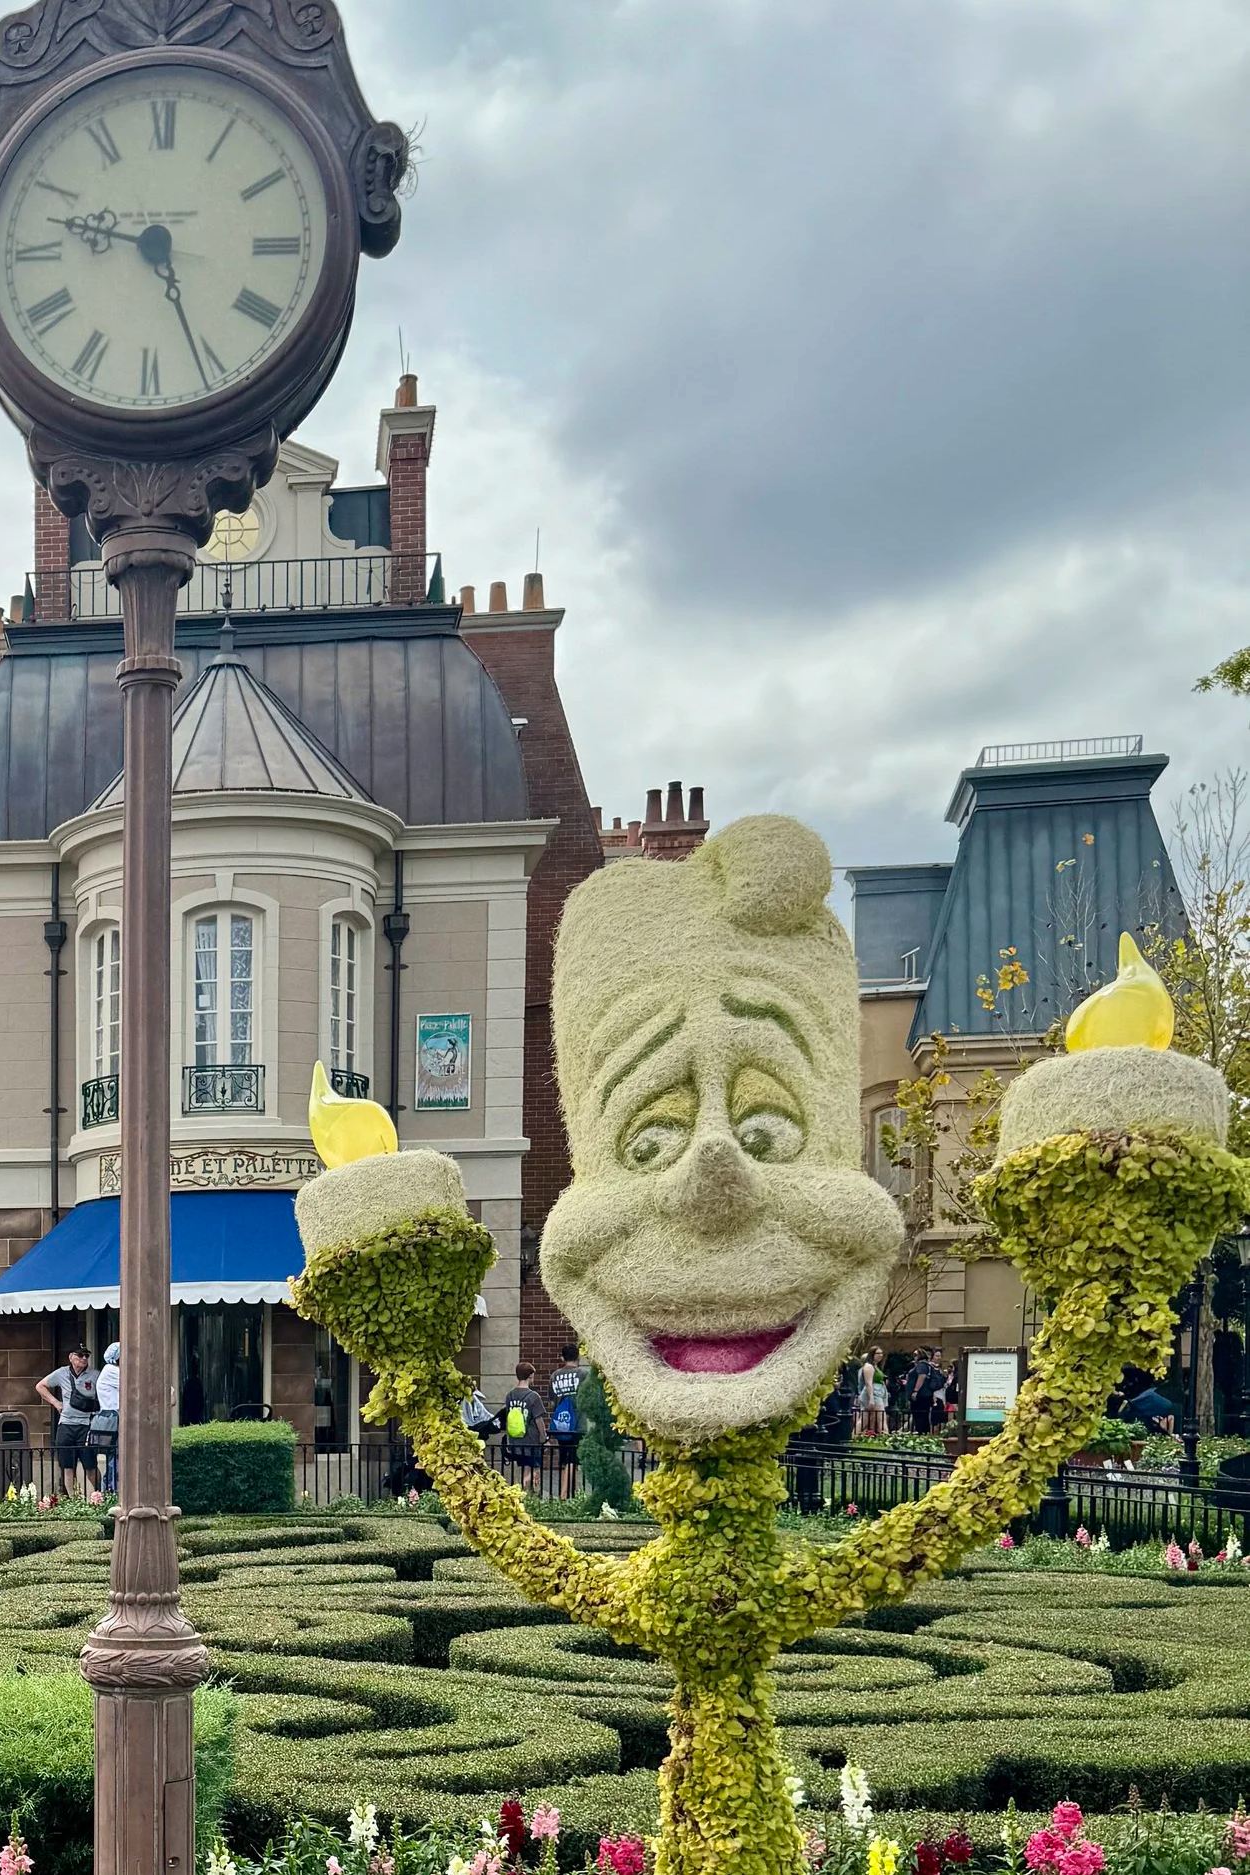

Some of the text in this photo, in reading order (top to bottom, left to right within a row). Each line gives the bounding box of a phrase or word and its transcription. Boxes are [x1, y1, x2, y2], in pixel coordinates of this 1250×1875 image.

[85, 118, 121, 170] XI
[149, 100, 177, 150] XII
[206, 117, 237, 163] I
[240, 167, 286, 202] II
[16, 240, 63, 262] IX
[252, 237, 301, 256] III
[25, 287, 78, 336] VIII
[71, 329, 111, 382] VII
[140, 347, 161, 396] VI
[200, 334, 228, 380] V
[202, 1157, 227, 1174] ET
[233, 1156, 317, 1174] PALETTE
